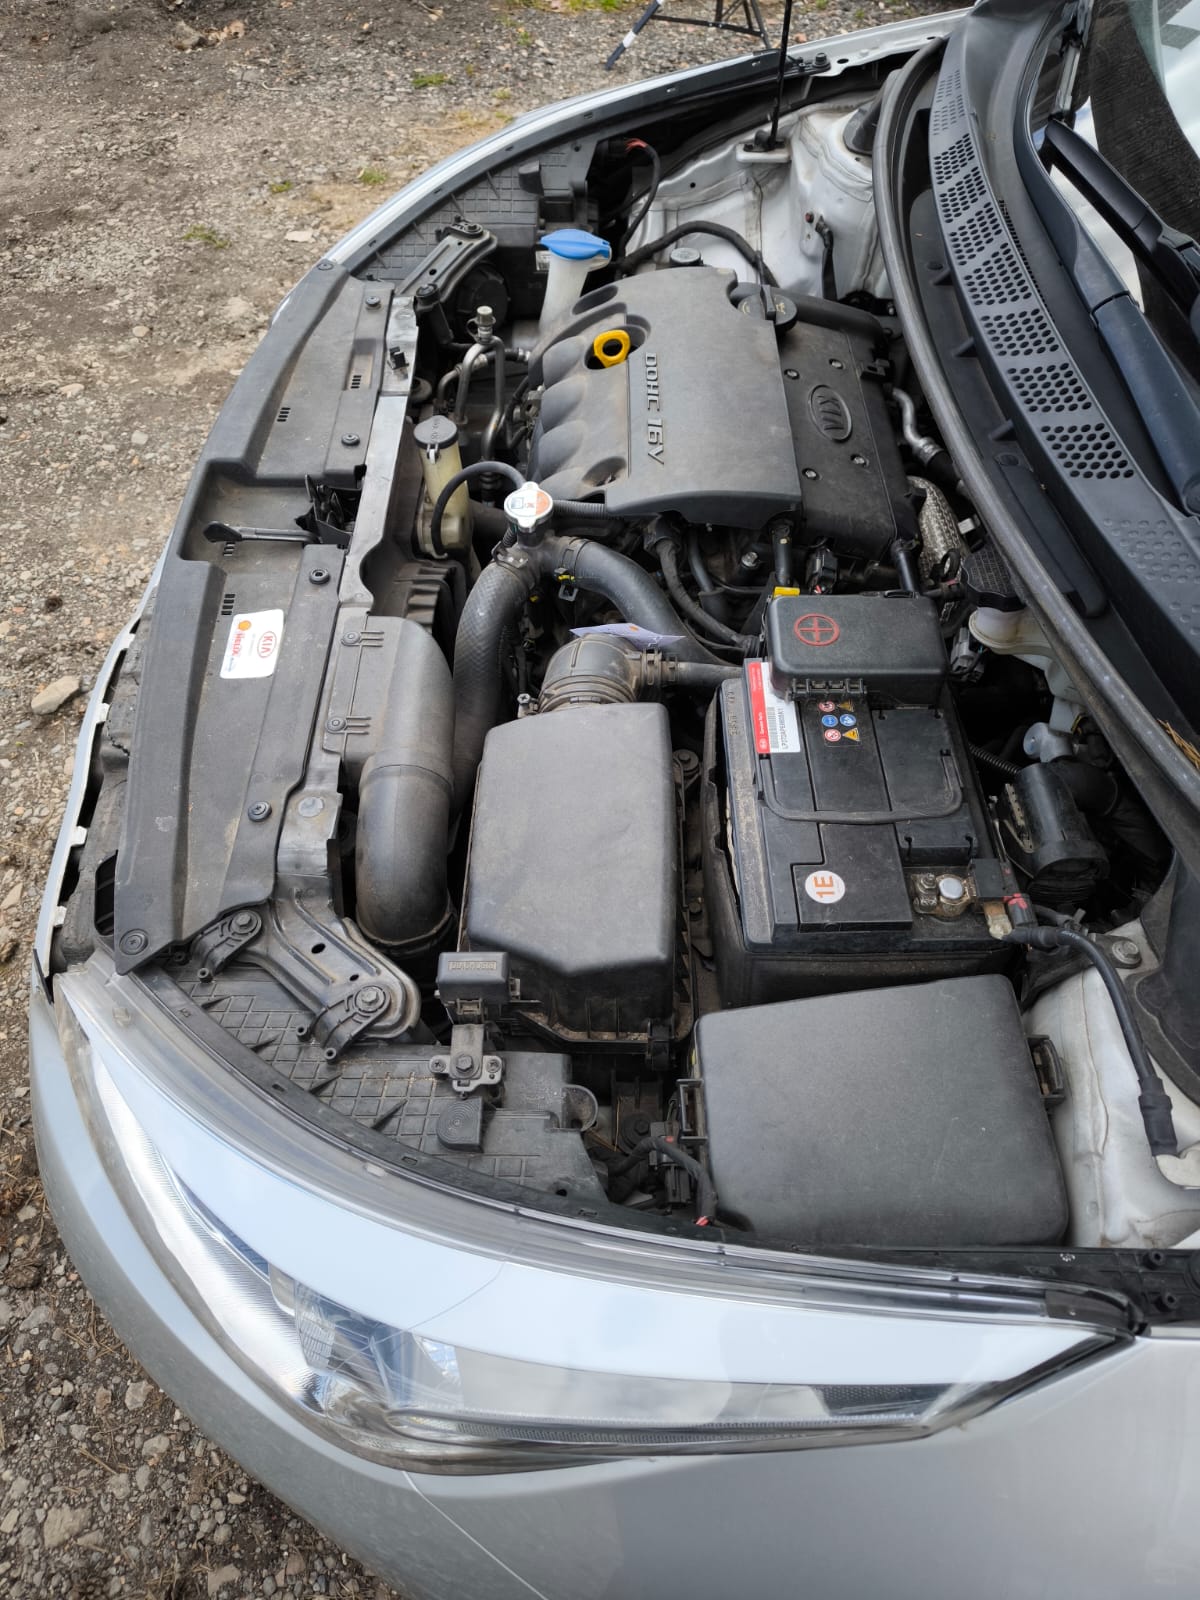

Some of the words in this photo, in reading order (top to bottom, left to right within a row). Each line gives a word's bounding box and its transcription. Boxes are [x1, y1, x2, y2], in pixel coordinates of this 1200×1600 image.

[646, 352, 660, 412] DOHC
[816, 395, 844, 431] KIA
[648, 419, 664, 466] 16V
[261, 635, 274, 653] KIA
[813, 875, 835, 898] 1E
